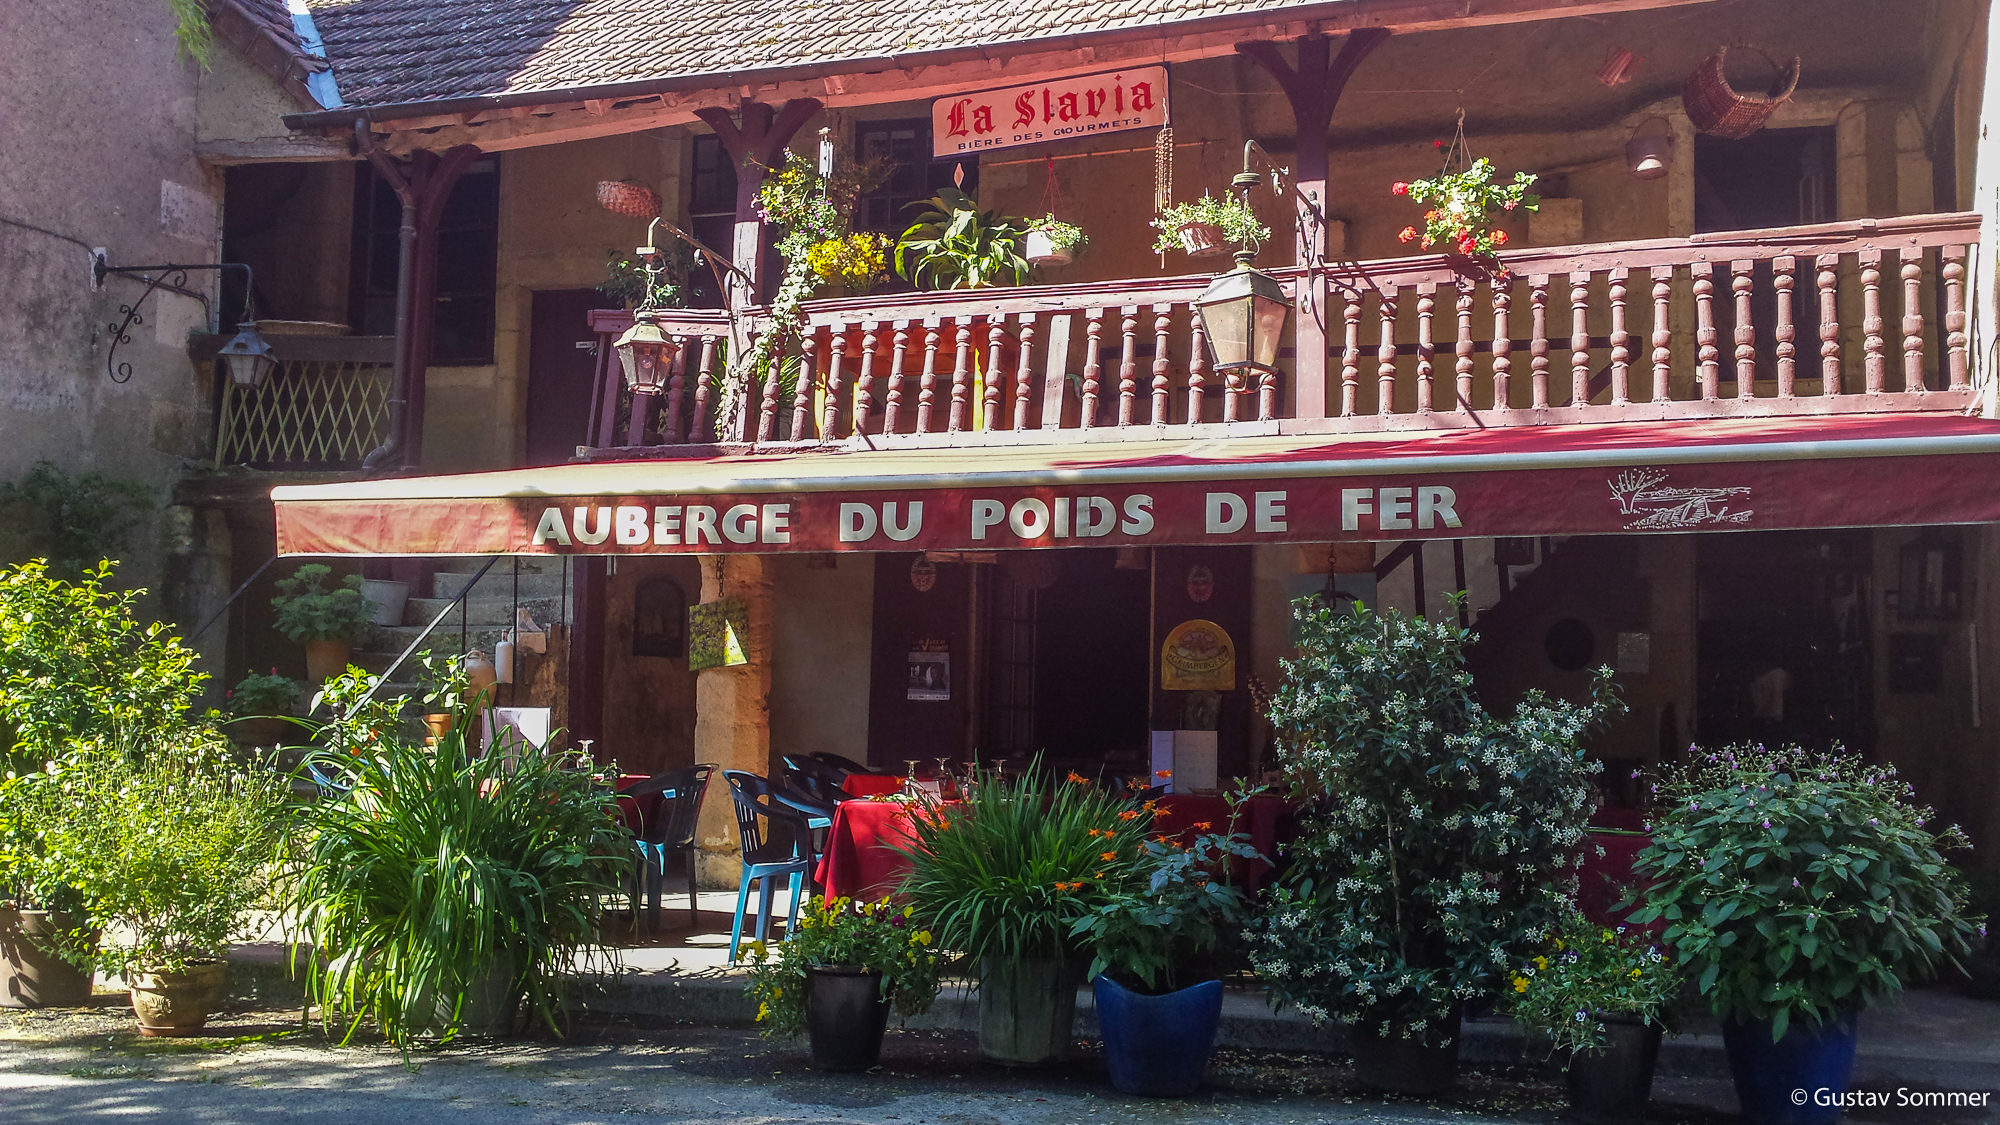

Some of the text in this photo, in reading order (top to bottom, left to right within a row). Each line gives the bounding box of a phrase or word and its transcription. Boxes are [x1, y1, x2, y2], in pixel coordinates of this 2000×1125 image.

[945, 73, 1156, 139] La Slavia
[1013, 131, 1043, 142] DES
[1053, 117, 1142, 136] GOURMETS
[532, 485, 1463, 546] AUBERGE DU POIDS DE FER
[1171, 656, 1225, 670] GRIMBERGEN
